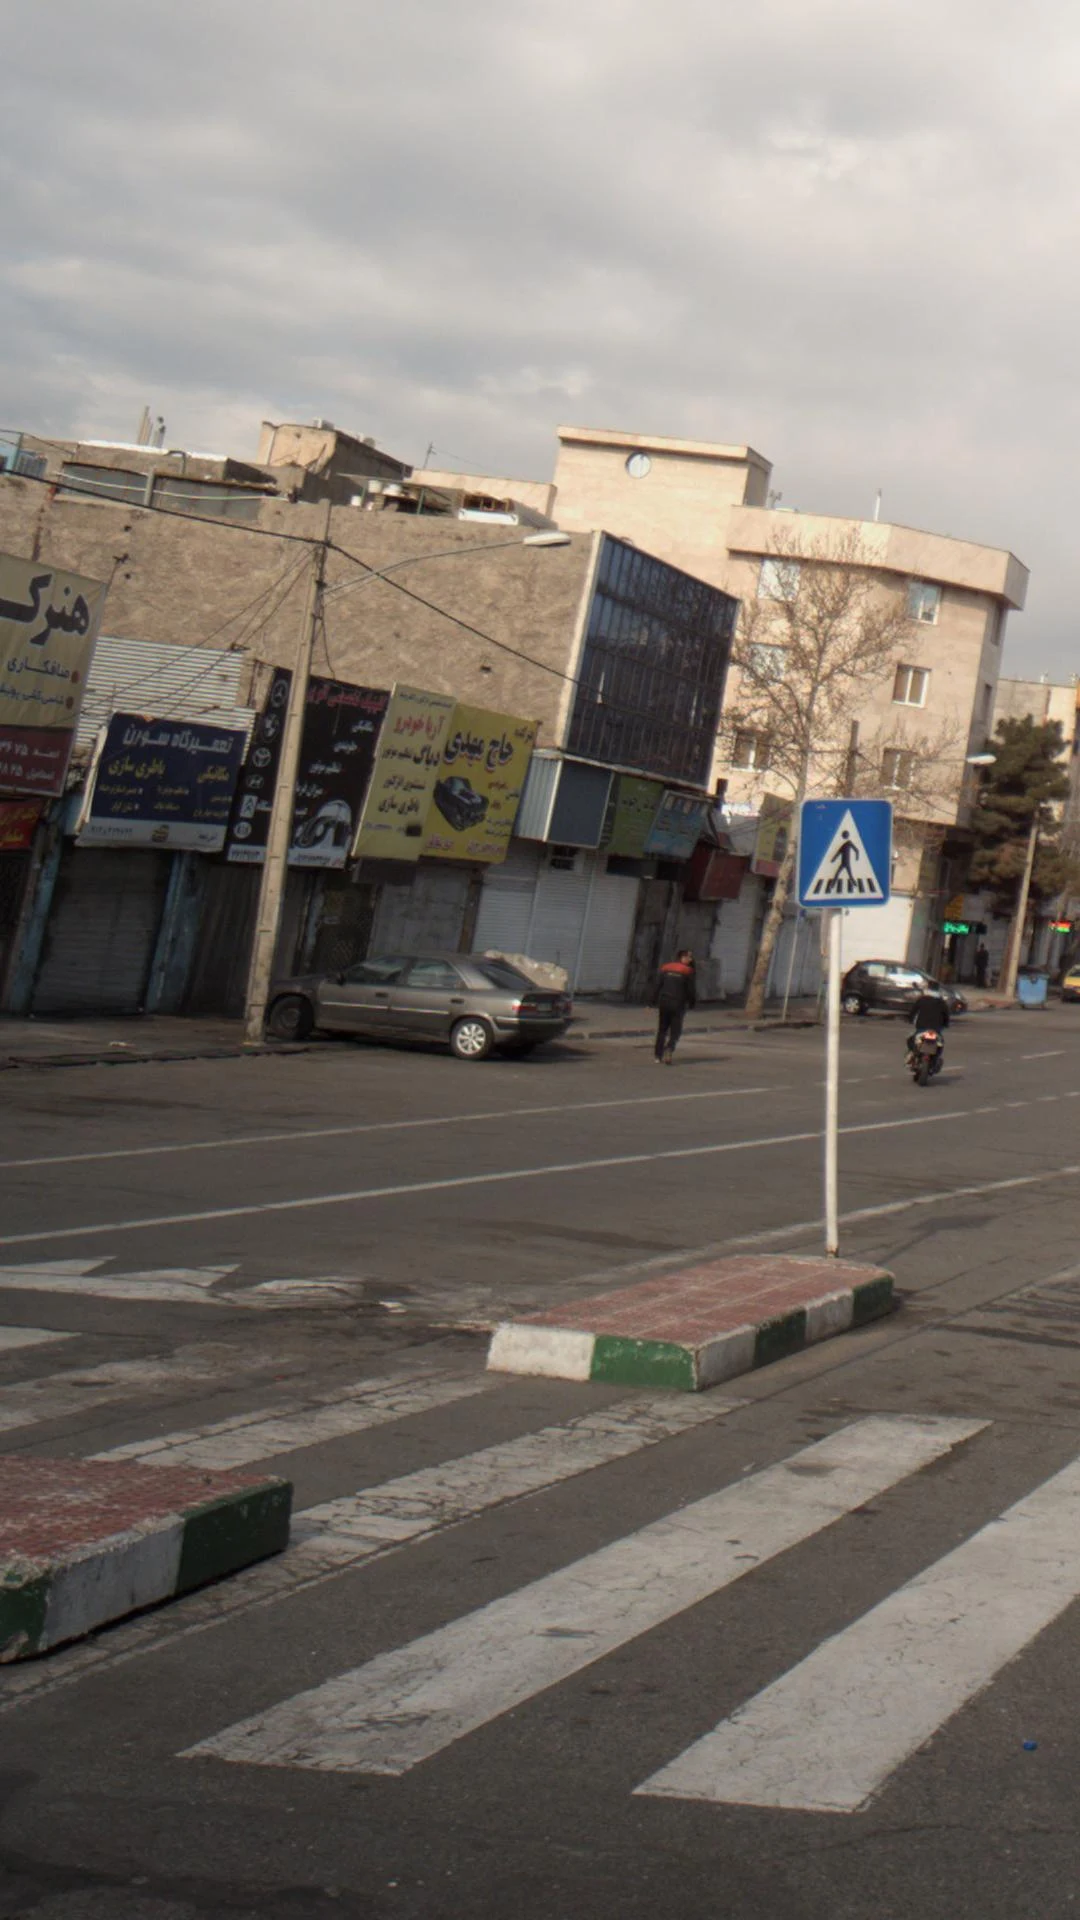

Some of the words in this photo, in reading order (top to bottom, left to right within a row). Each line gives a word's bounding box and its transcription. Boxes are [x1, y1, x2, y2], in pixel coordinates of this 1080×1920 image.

[0, 573, 90, 646] هنرک
[393, 715, 424, 737] خودرو
[170, 729, 235, 755] تعمیرگاه
[485, 731, 514, 773] حاج
[107, 754, 135, 777] سازی
[134, 756, 167, 779] باطری
